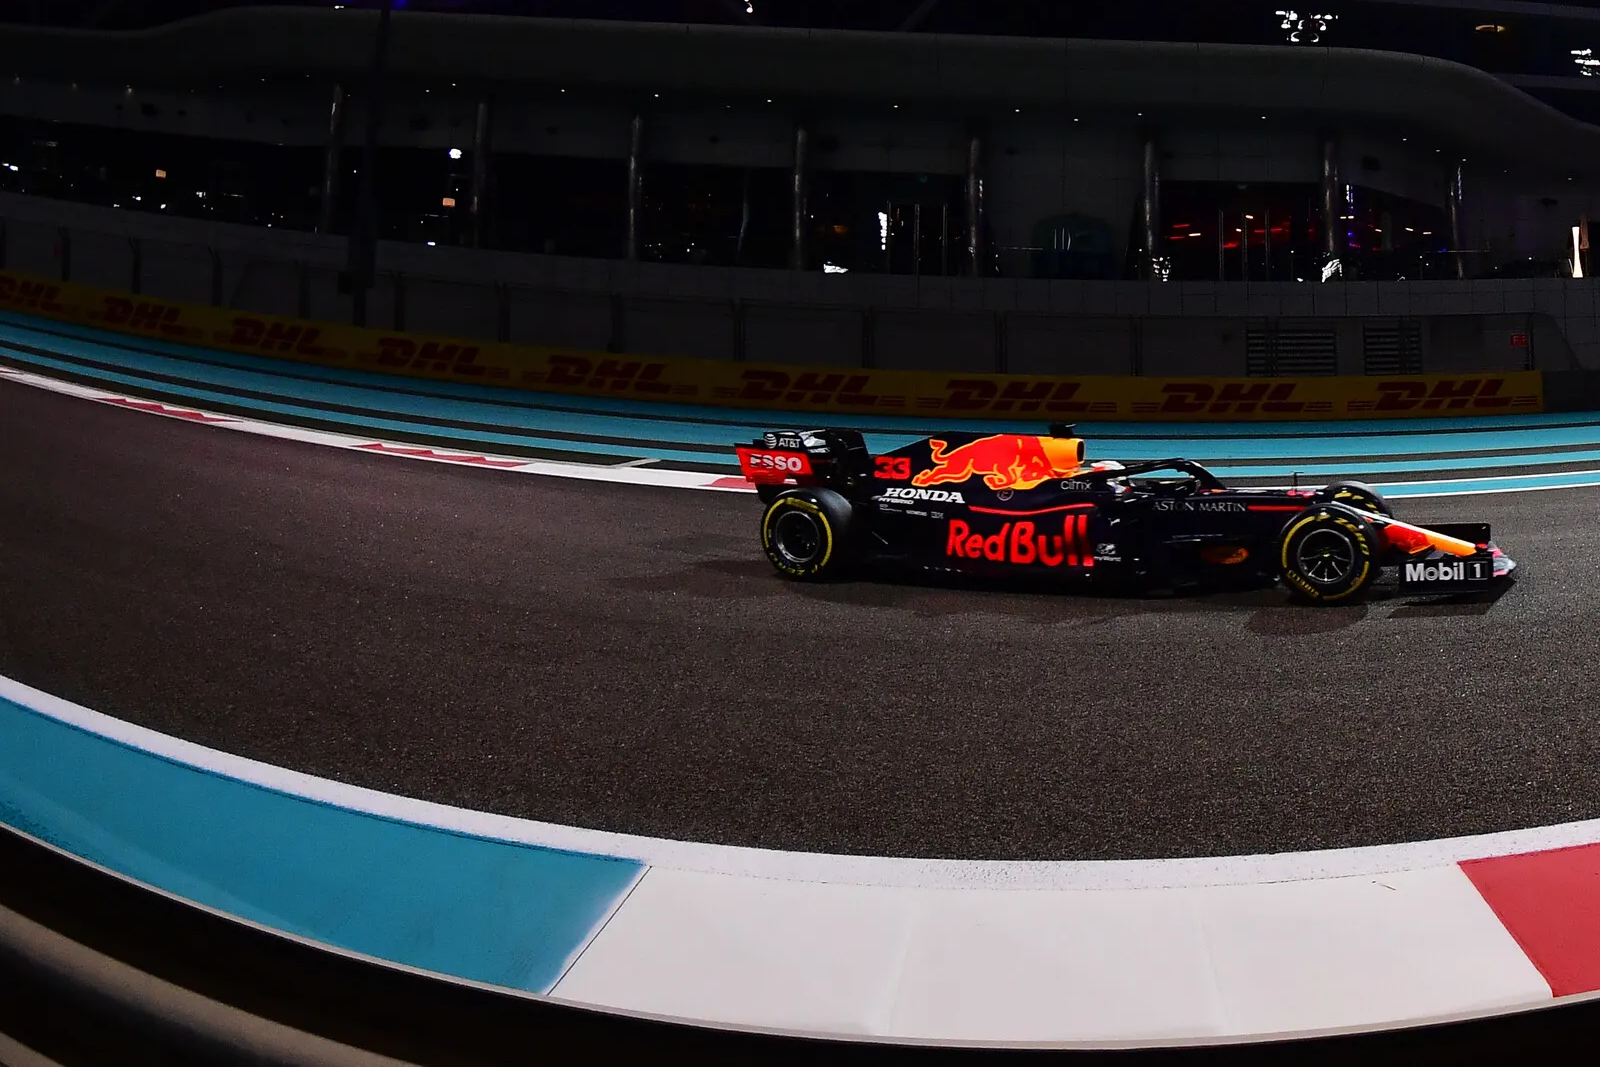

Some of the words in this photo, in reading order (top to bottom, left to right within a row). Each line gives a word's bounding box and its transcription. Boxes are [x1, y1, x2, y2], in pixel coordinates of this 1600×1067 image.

[0, 276, 61, 312] DHL
[103, 296, 185, 334] DHL
[230, 317, 327, 357] DHL
[377, 337, 488, 376] DHL
[544, 355, 671, 395] DHL
[737, 370, 879, 405] DHL
[942, 379, 1088, 413] DHL
[1156, 383, 1306, 414] DHL
[1372, 380, 1512, 409] DHL
[778, 438, 801, 448] AT&T
[750, 454, 802, 472] ESSO
[873, 456, 912, 480] 33
[882, 488, 966, 504] HONDA
[1152, 501, 1195, 512] ASTON
[1199, 501, 1246, 512] MARTIN
[1405, 562, 1465, 582] Mobil
